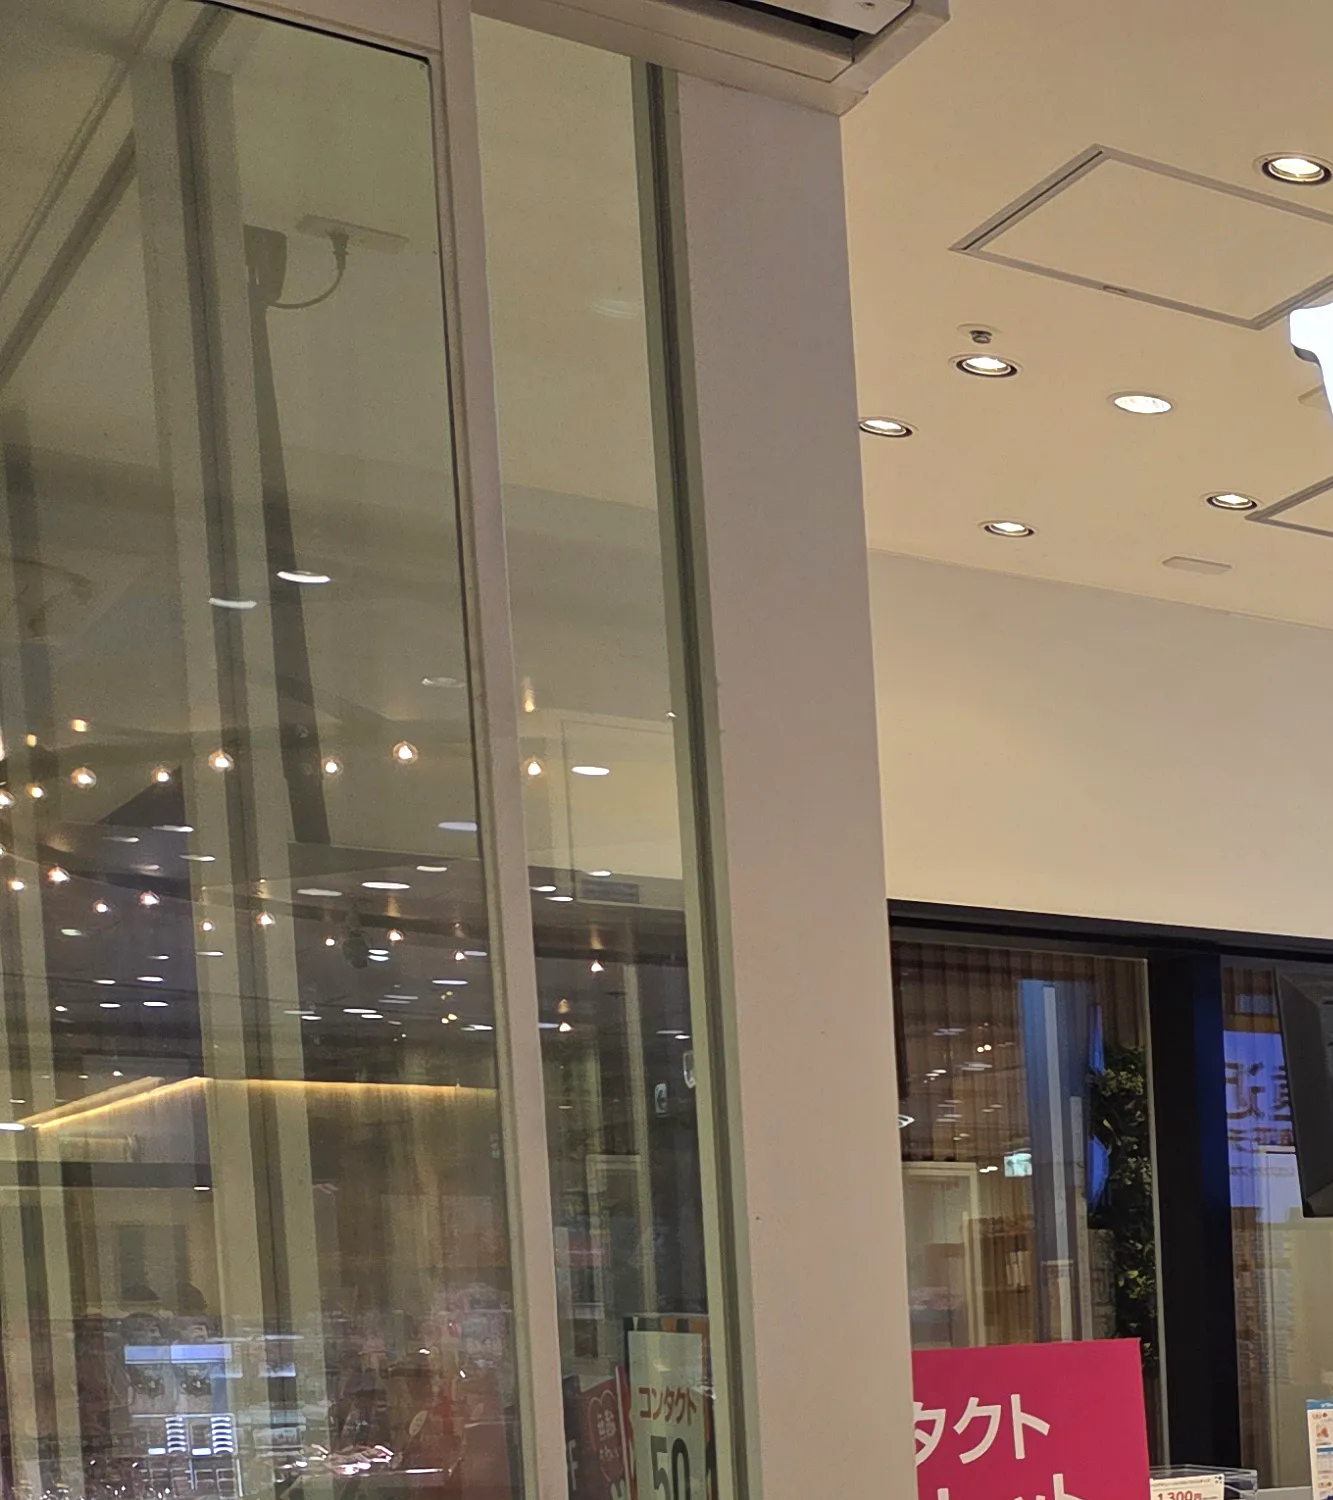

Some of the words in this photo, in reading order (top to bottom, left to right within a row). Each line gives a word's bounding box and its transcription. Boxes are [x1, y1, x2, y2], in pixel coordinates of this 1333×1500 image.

[638, 1386, 697, 1427] コンタクト
